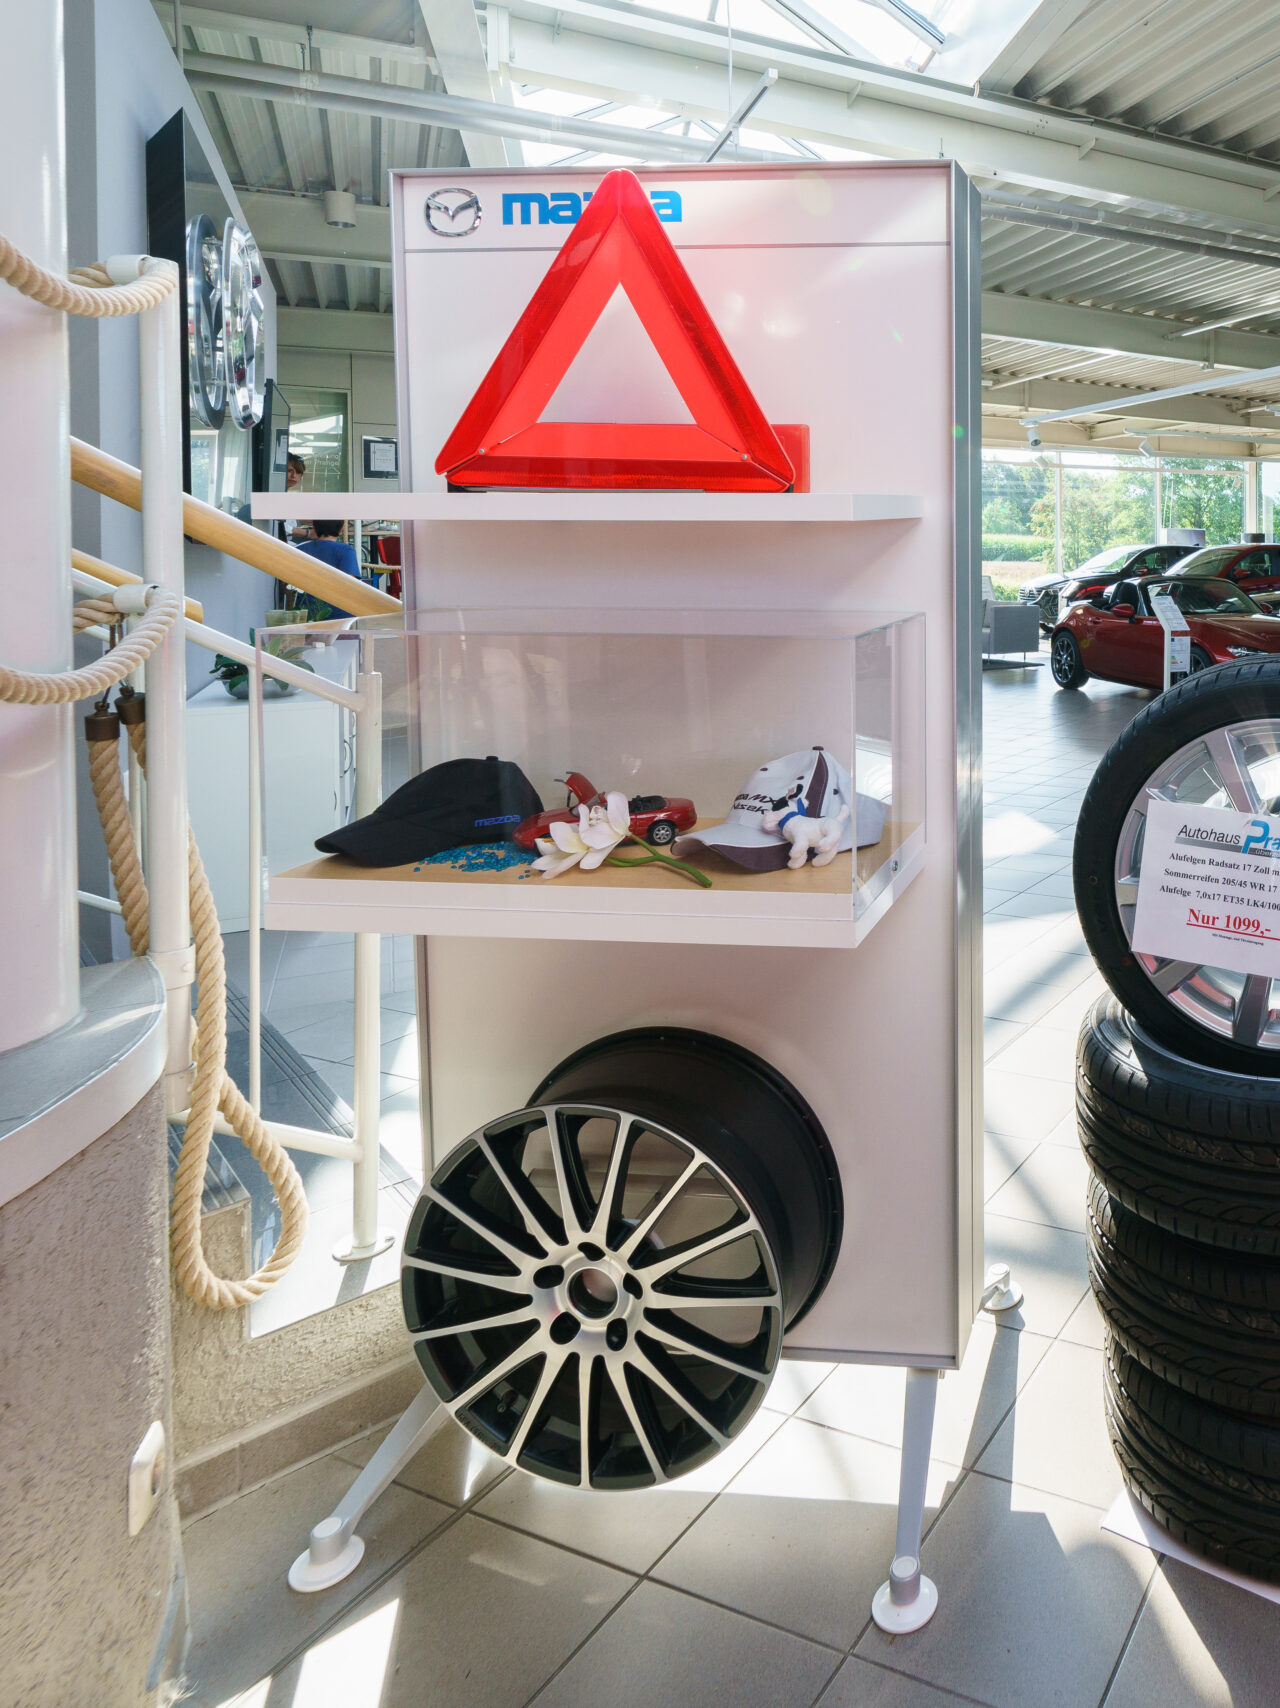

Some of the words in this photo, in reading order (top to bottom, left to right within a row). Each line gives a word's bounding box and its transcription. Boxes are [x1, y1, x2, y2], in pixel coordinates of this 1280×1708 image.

[502, 190, 682, 225] maa
[1178, 824, 1241, 845] Autohaus
[1169, 852, 1205, 866] Alufelgen
[1208, 858, 1240, 869] Radsatz
[1242, 863, 1251, 871] 17
[1253, 865, 1269, 874] Zoll
[1164, 868, 1219, 883] Sommerreifen
[1221, 877, 1247, 888] 205/45
[1249, 881, 1265, 890] WR
[1268, 884, 1277, 892] 17
[1159, 884, 1191, 897] Alufelge
[1223, 894, 1244, 905] ET35
[1246, 898, 1280, 911] LK4/100
[1187, 908, 1219, 926] Nur
[1223, 914, 1272, 937] 1099,-
